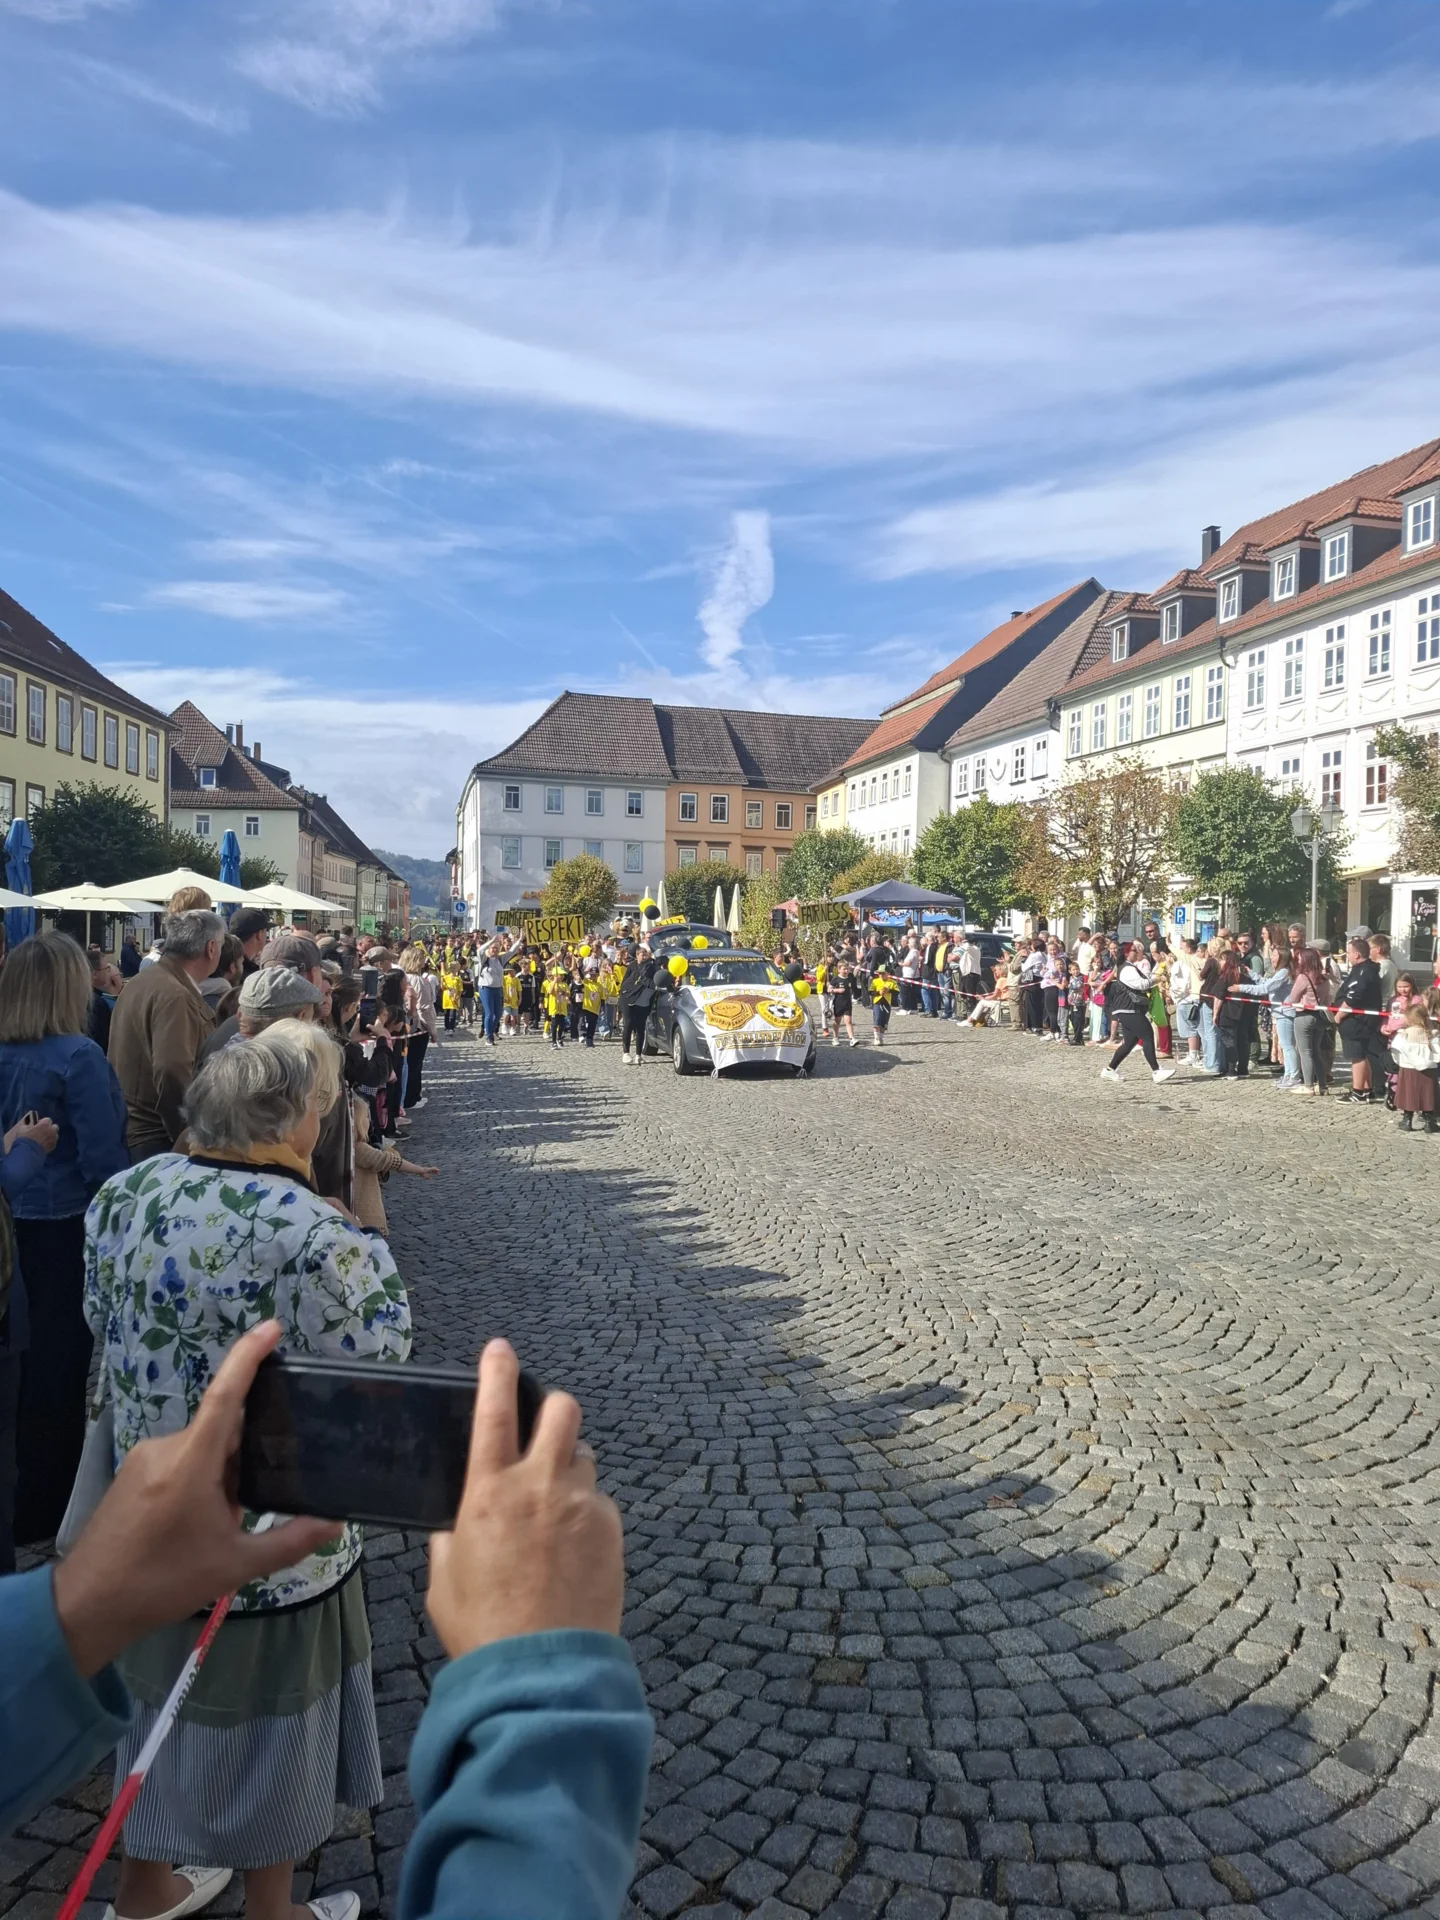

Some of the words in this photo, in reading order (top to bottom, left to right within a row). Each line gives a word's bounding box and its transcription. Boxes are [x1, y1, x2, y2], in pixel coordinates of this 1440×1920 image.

[800, 901, 849, 925] FAIRNESS
[1176, 908, 1184, 923] P
[527, 915, 582, 944] RESPEKT
